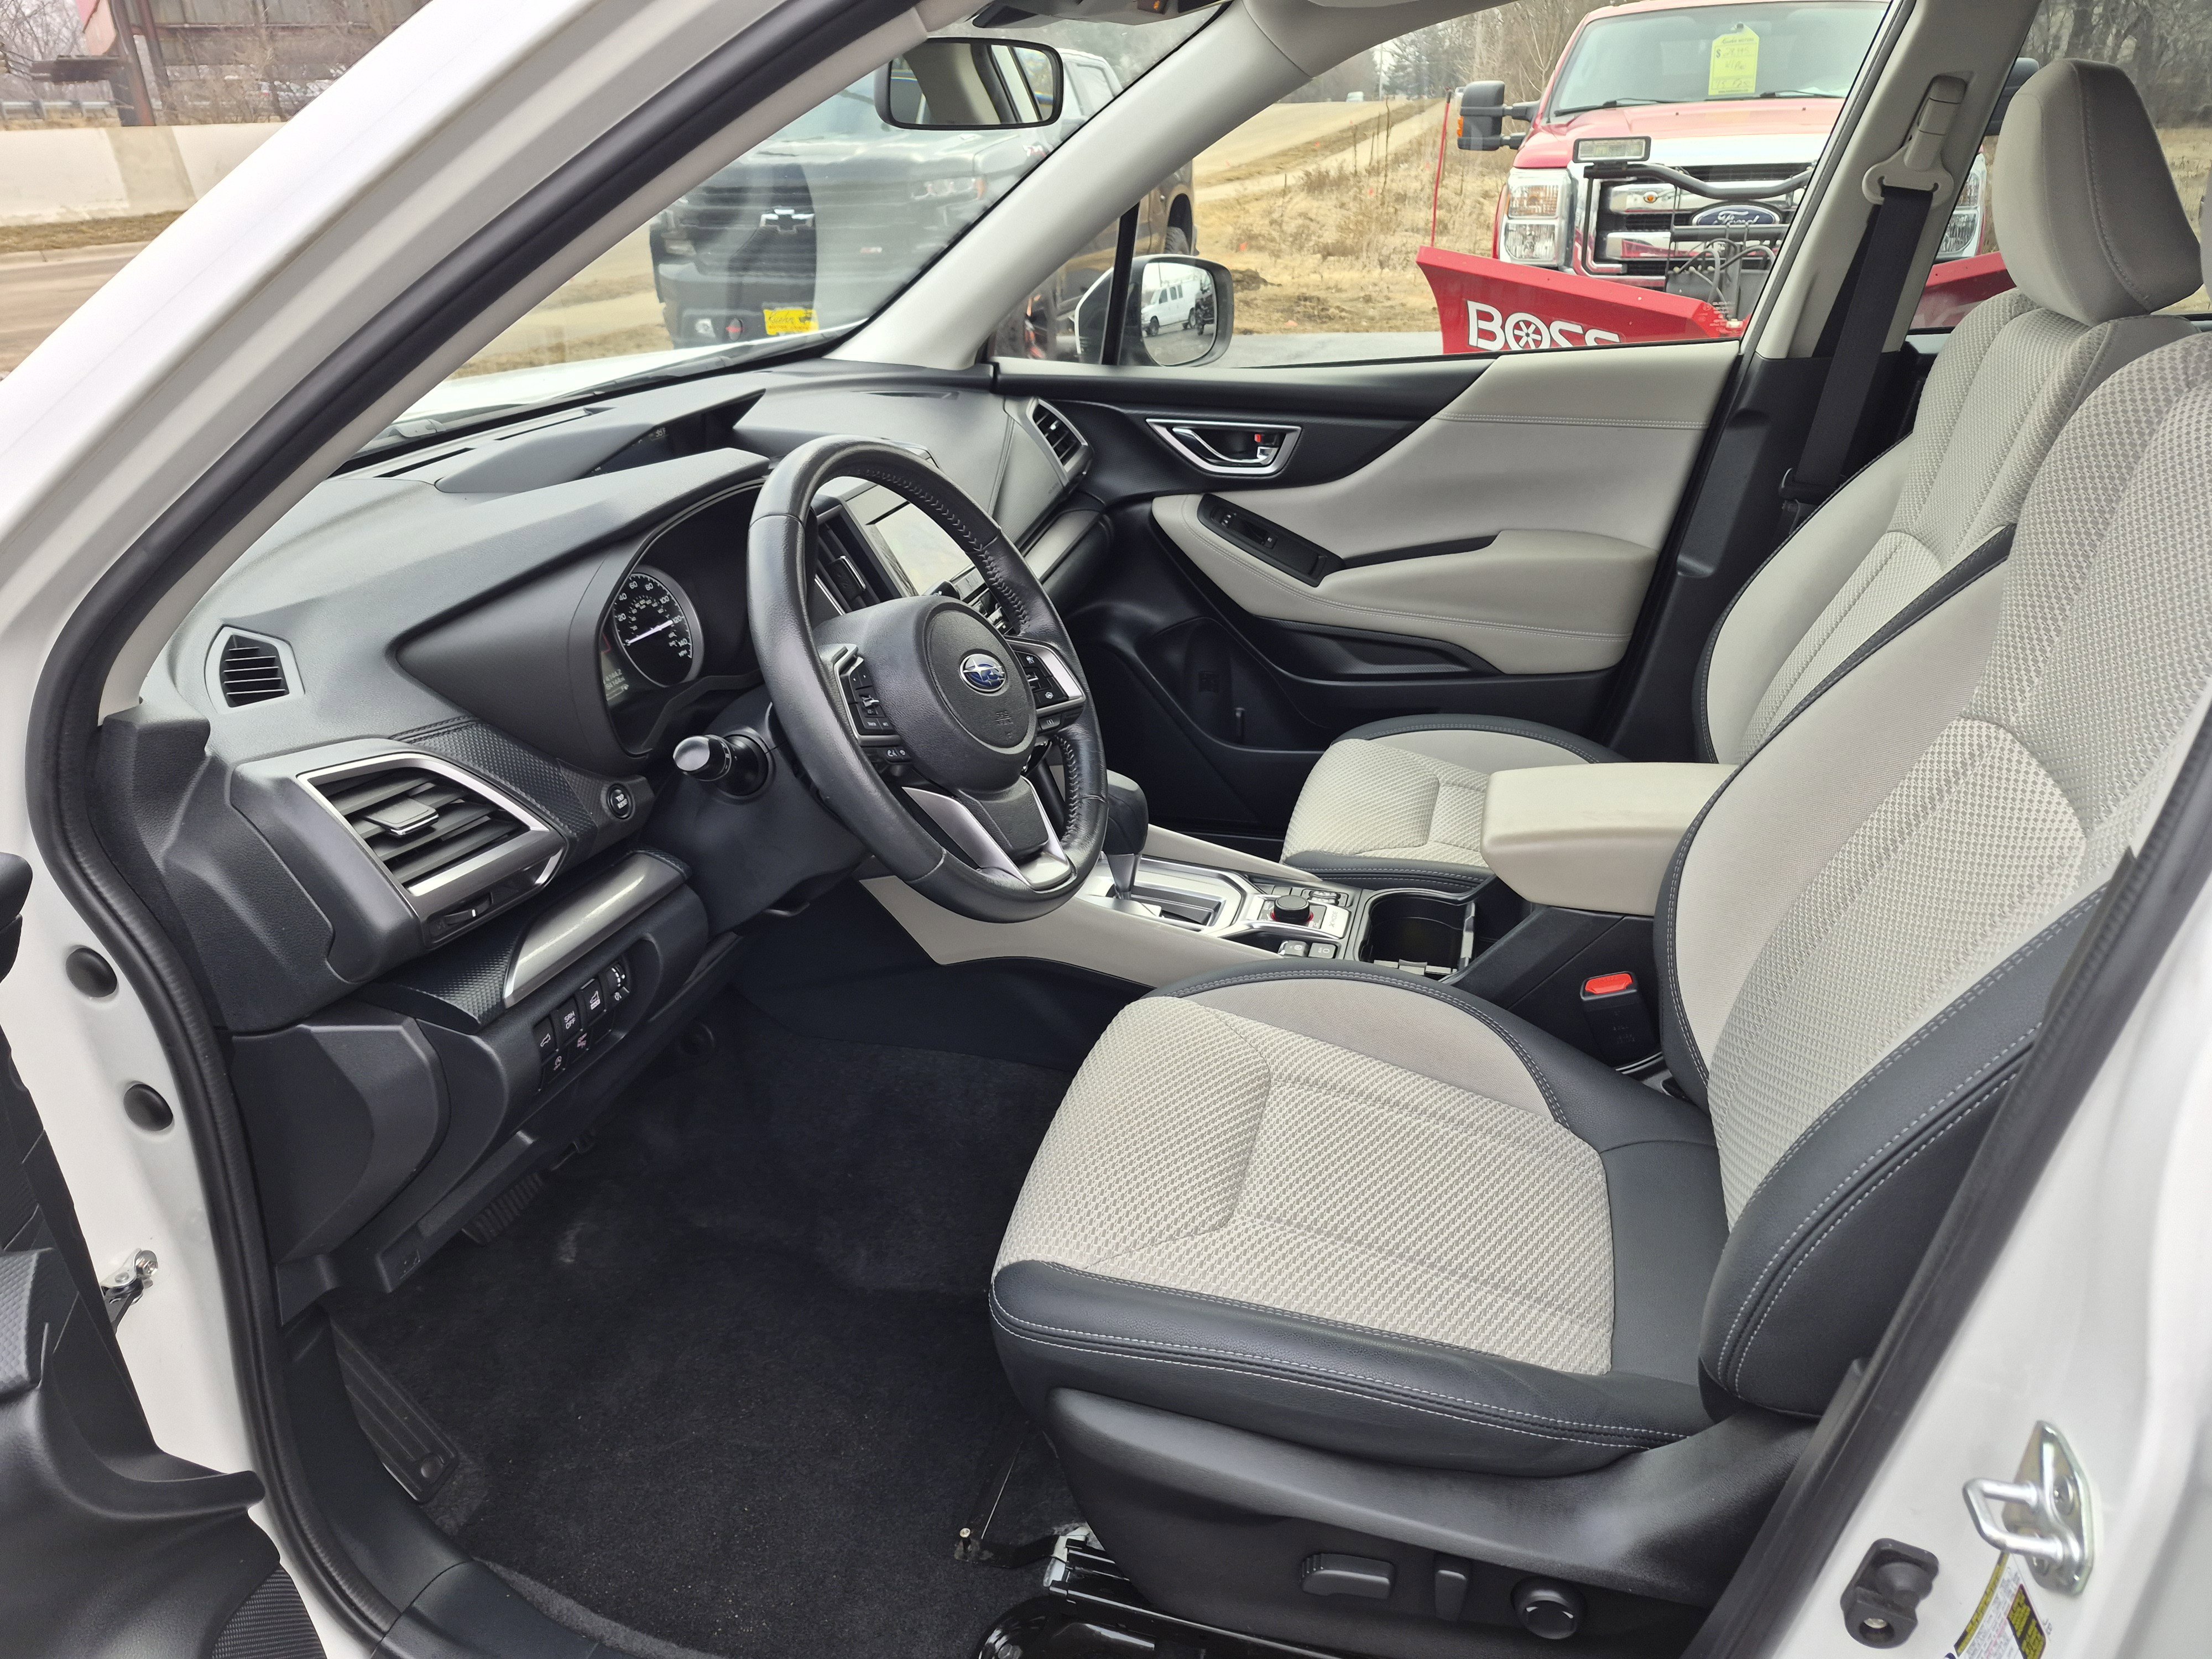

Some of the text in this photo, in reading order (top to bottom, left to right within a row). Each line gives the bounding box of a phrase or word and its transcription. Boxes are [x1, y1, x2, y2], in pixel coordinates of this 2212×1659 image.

[1716, 49, 1721, 58] $
[629, 581, 638, 589] 60
[645, 583, 654, 591] 80
[619, 593, 628, 601] 40
[659, 595, 670, 604] 100
[618, 613, 627, 622] 20
[672, 615, 682, 624] 120
[678, 638, 688, 648] 140
[564, 1010, 576, 1023] SRH
[565, 1018, 576, 1030] OFF
